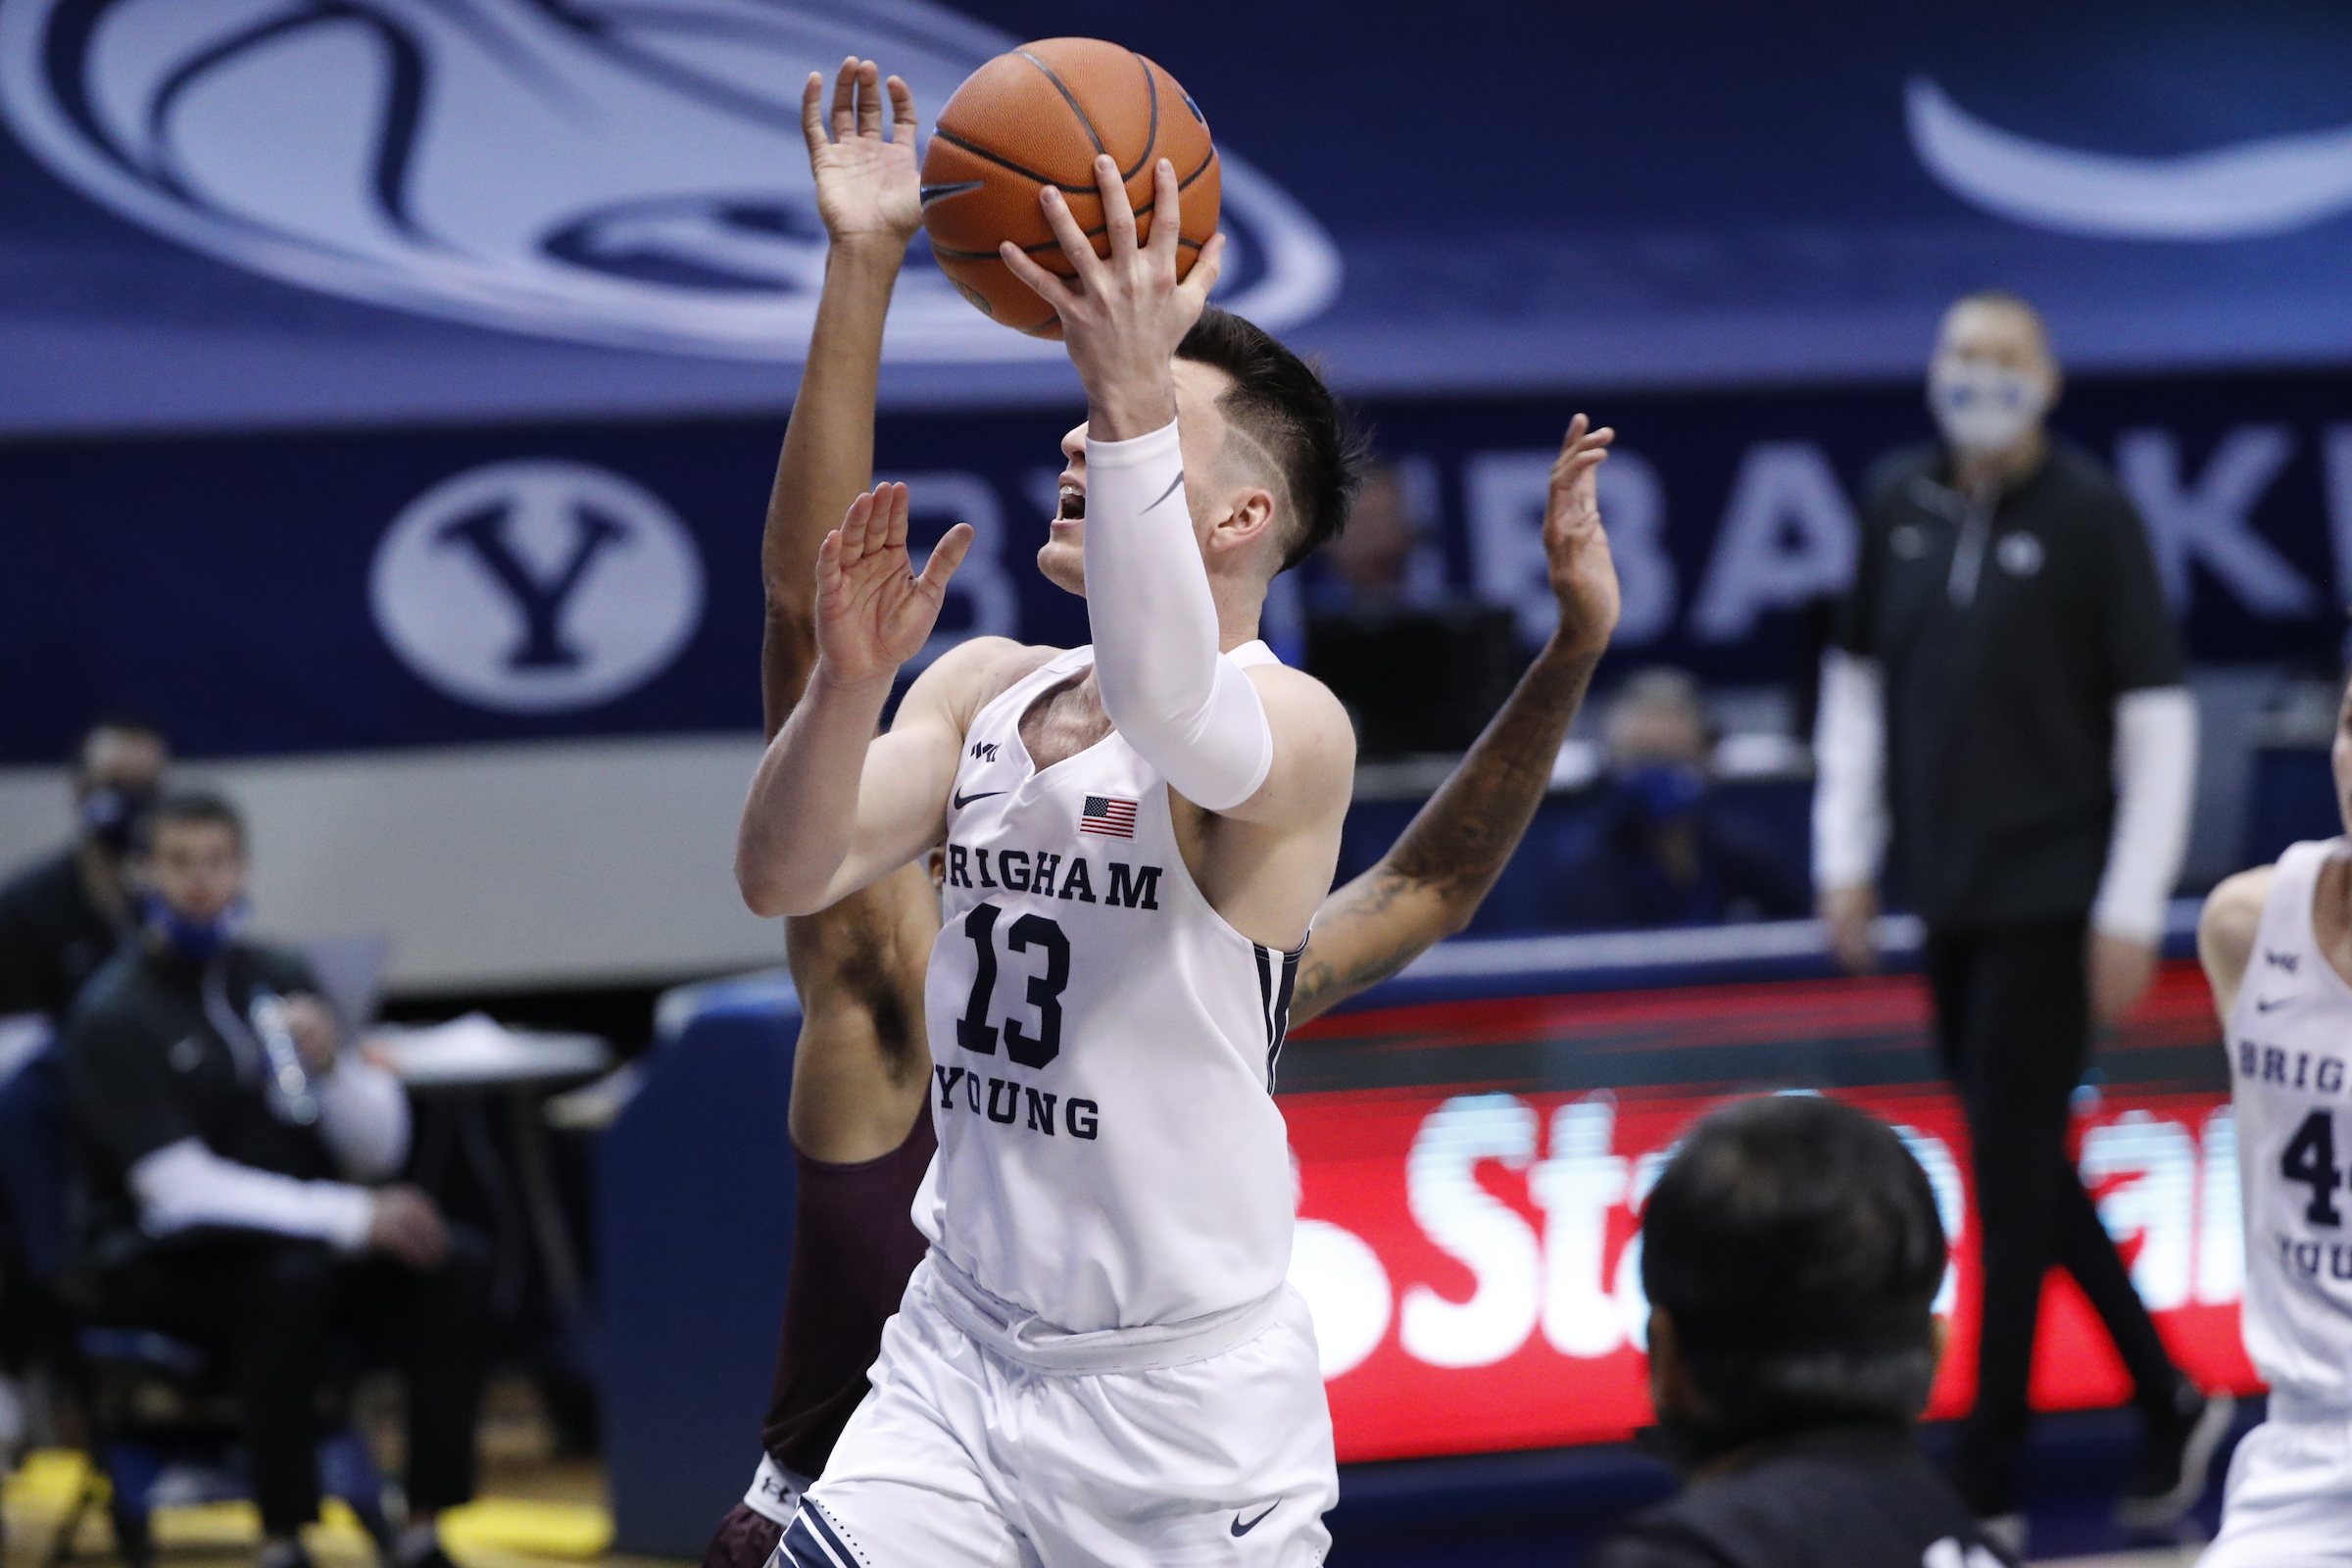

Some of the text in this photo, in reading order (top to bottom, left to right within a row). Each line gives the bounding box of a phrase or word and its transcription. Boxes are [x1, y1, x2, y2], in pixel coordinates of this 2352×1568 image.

[434, 498, 633, 671] Y
[943, 844, 1163, 910] RIGHAM
[956, 902, 1070, 1069] 13
[935, 1063, 1099, 1141] YOUNG
[2239, 1040, 2352, 1095] BRIG
[2280, 1108, 2352, 1228] 4
